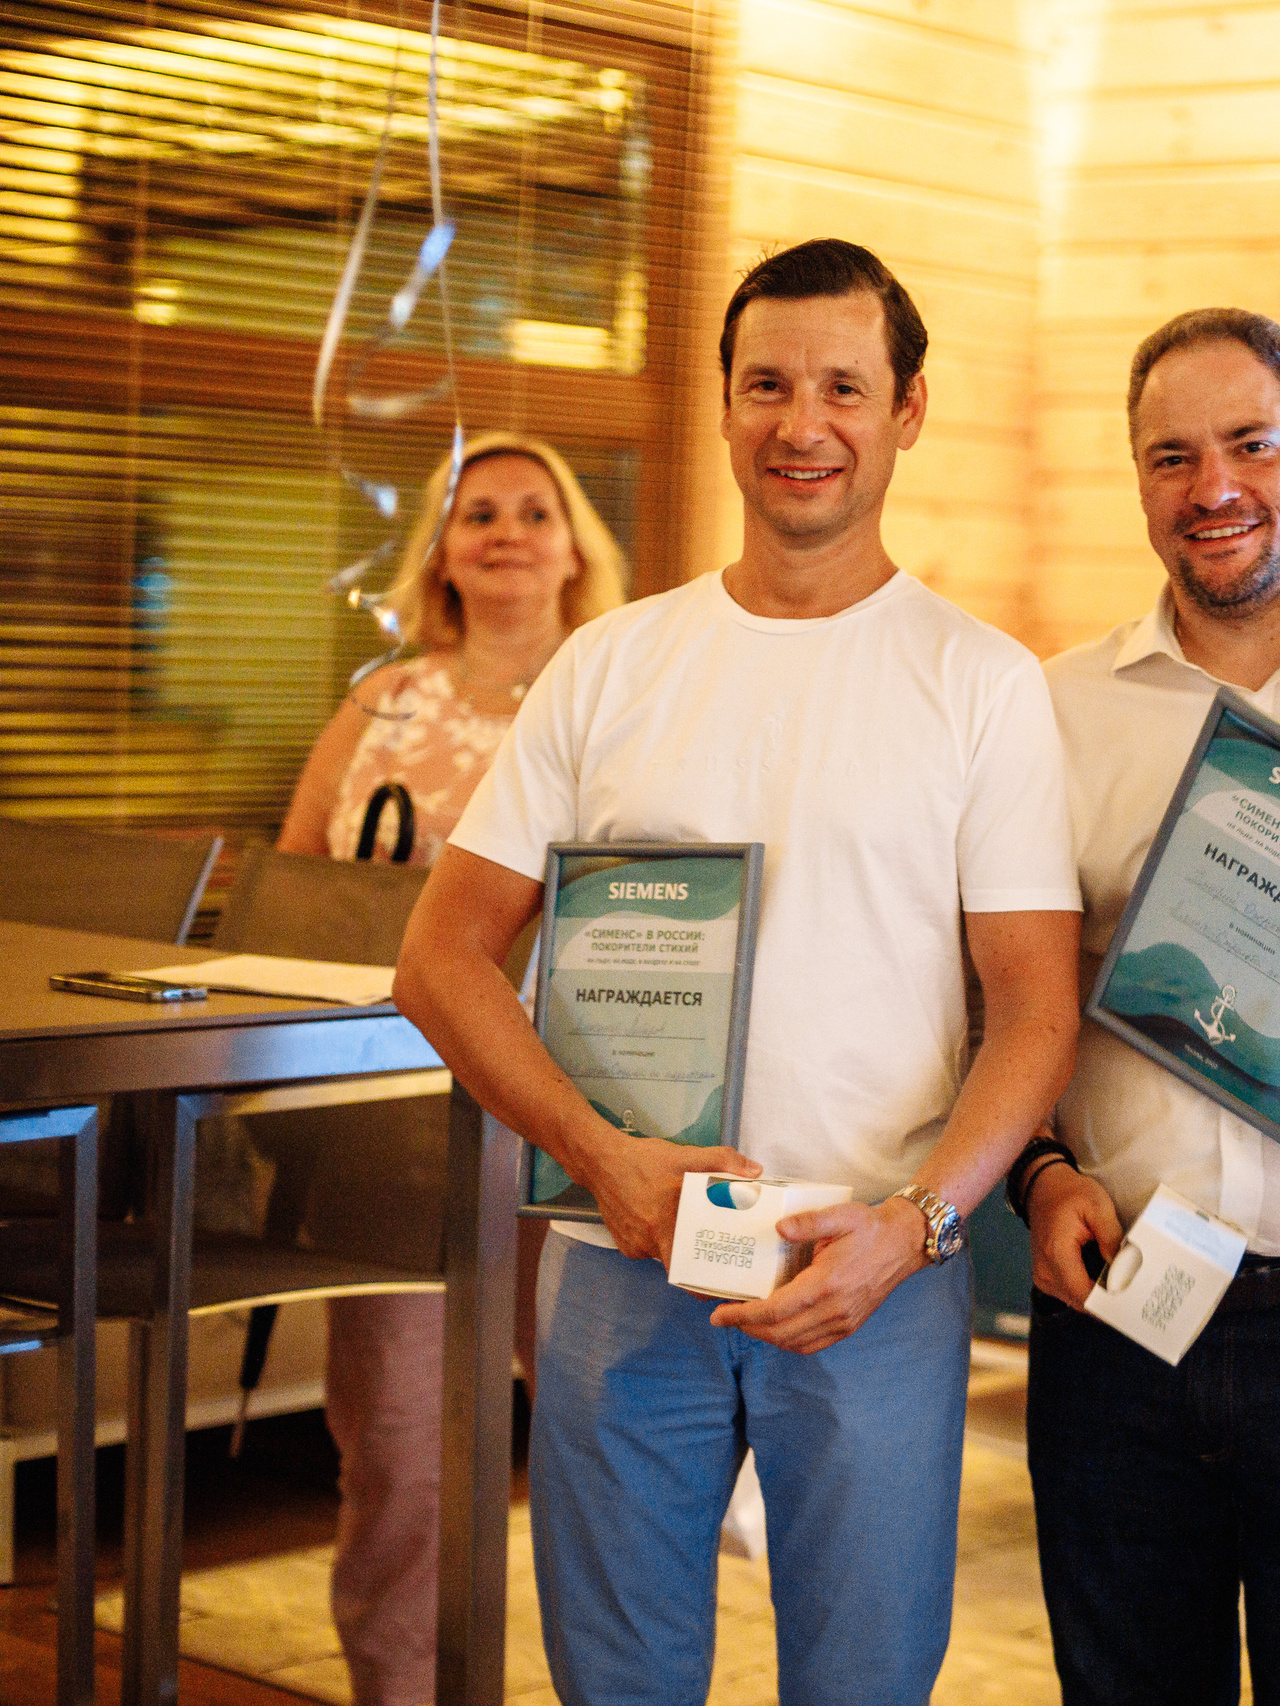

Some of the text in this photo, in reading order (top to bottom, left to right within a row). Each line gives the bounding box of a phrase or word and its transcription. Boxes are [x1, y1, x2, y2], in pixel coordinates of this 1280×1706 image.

[608, 882, 689, 901] SIEMENS
[646, 930, 654, 940] В
[591, 942, 699, 953] ПОКОРИТЕЛИ СТИХИЙ
[576, 988, 703, 1007] НАГРАЖДАЕТСЯ
[695, 1229, 756, 1247] COFFEE CUP
[694, 1248, 752, 1269] REUSABLE
